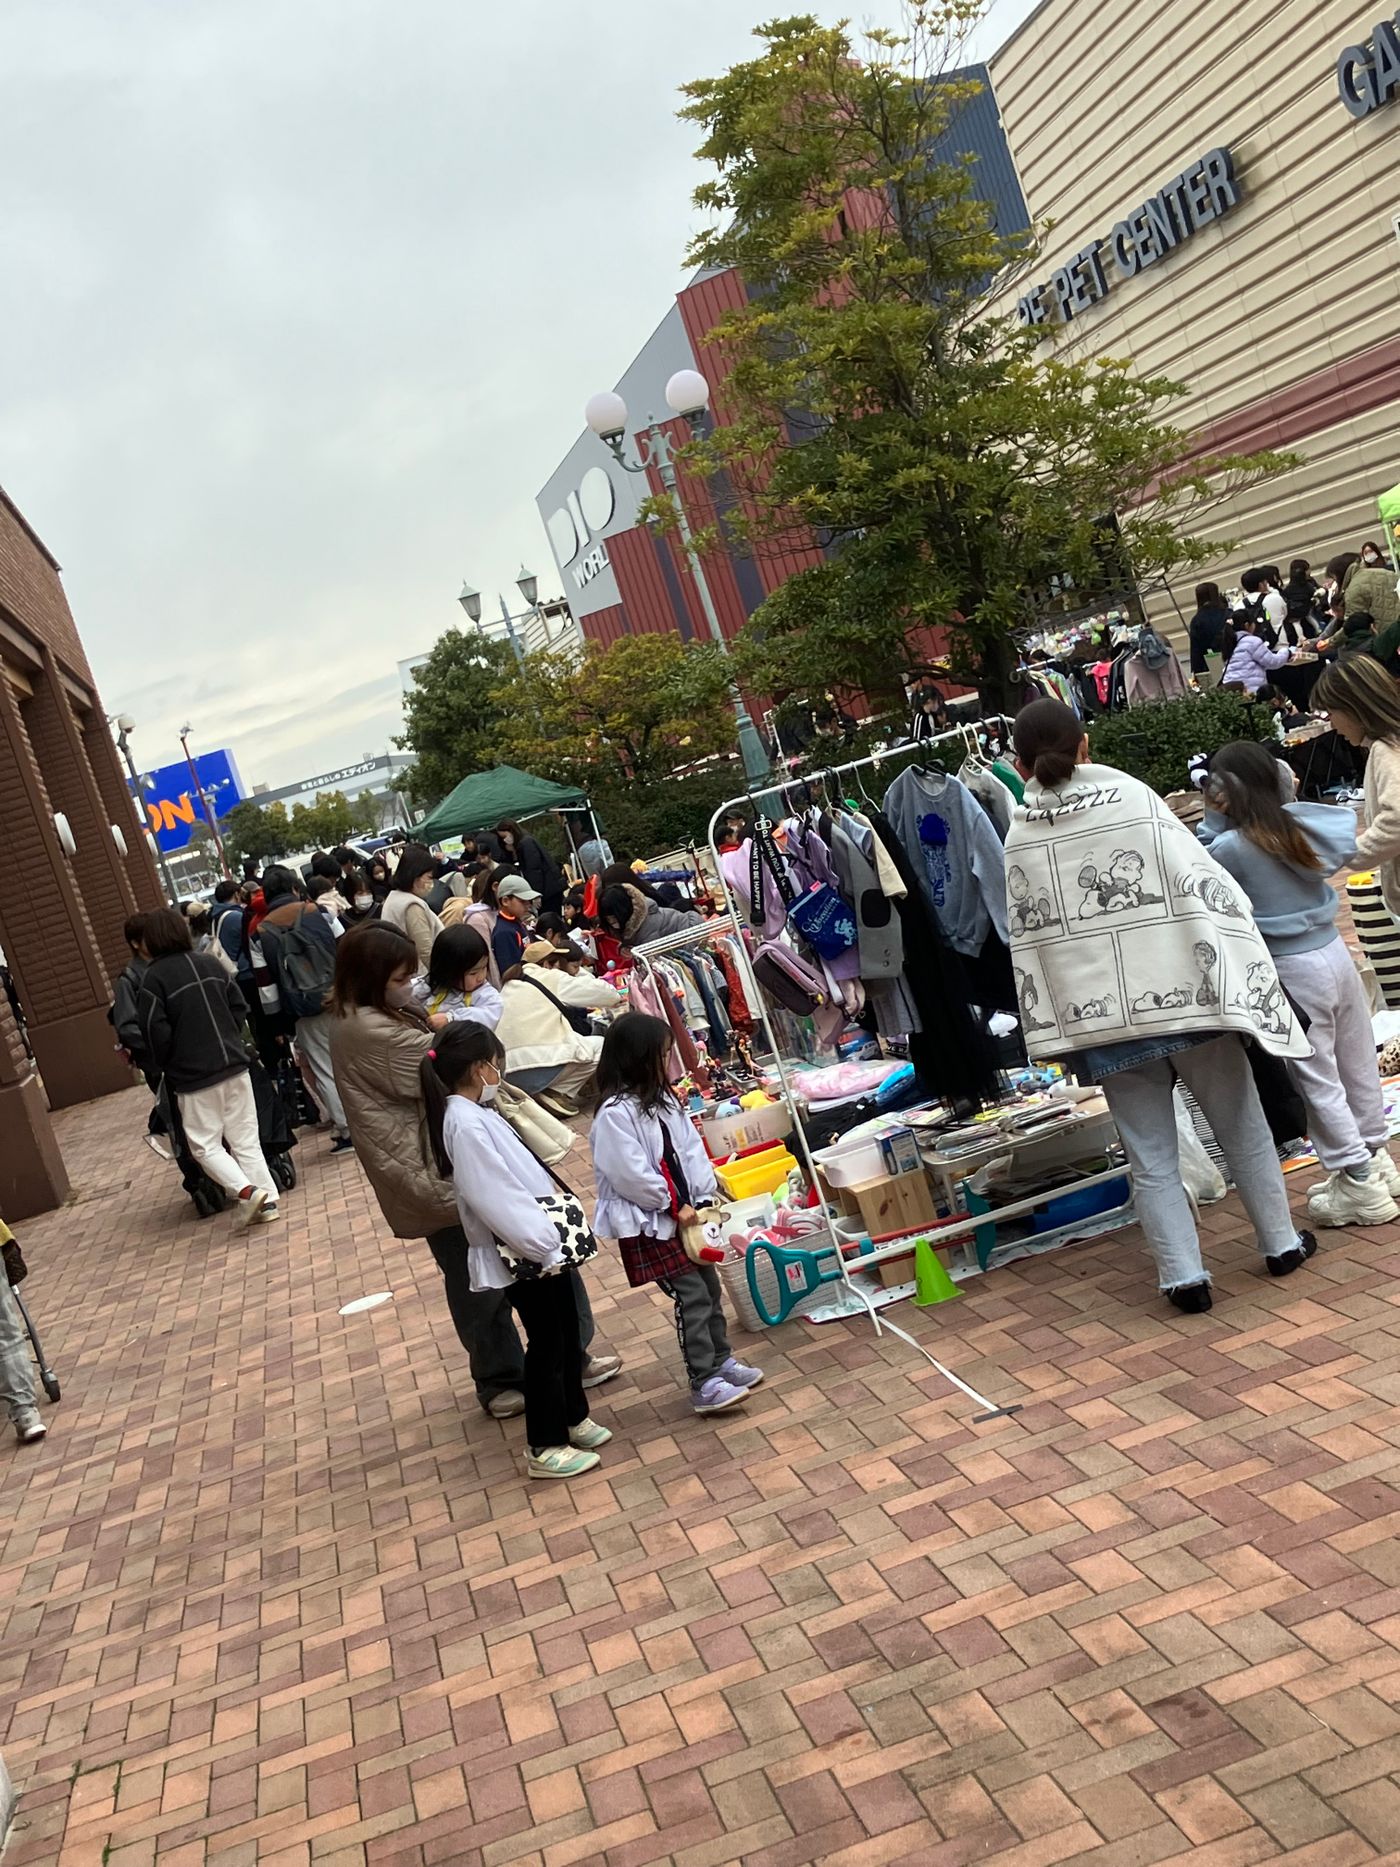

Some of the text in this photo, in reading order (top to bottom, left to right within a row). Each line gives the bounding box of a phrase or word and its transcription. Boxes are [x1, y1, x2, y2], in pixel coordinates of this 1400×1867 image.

[1051, 239, 1108, 323] PET
[1111, 146, 1239, 278] CENTER
[547, 467, 615, 568] DIO
